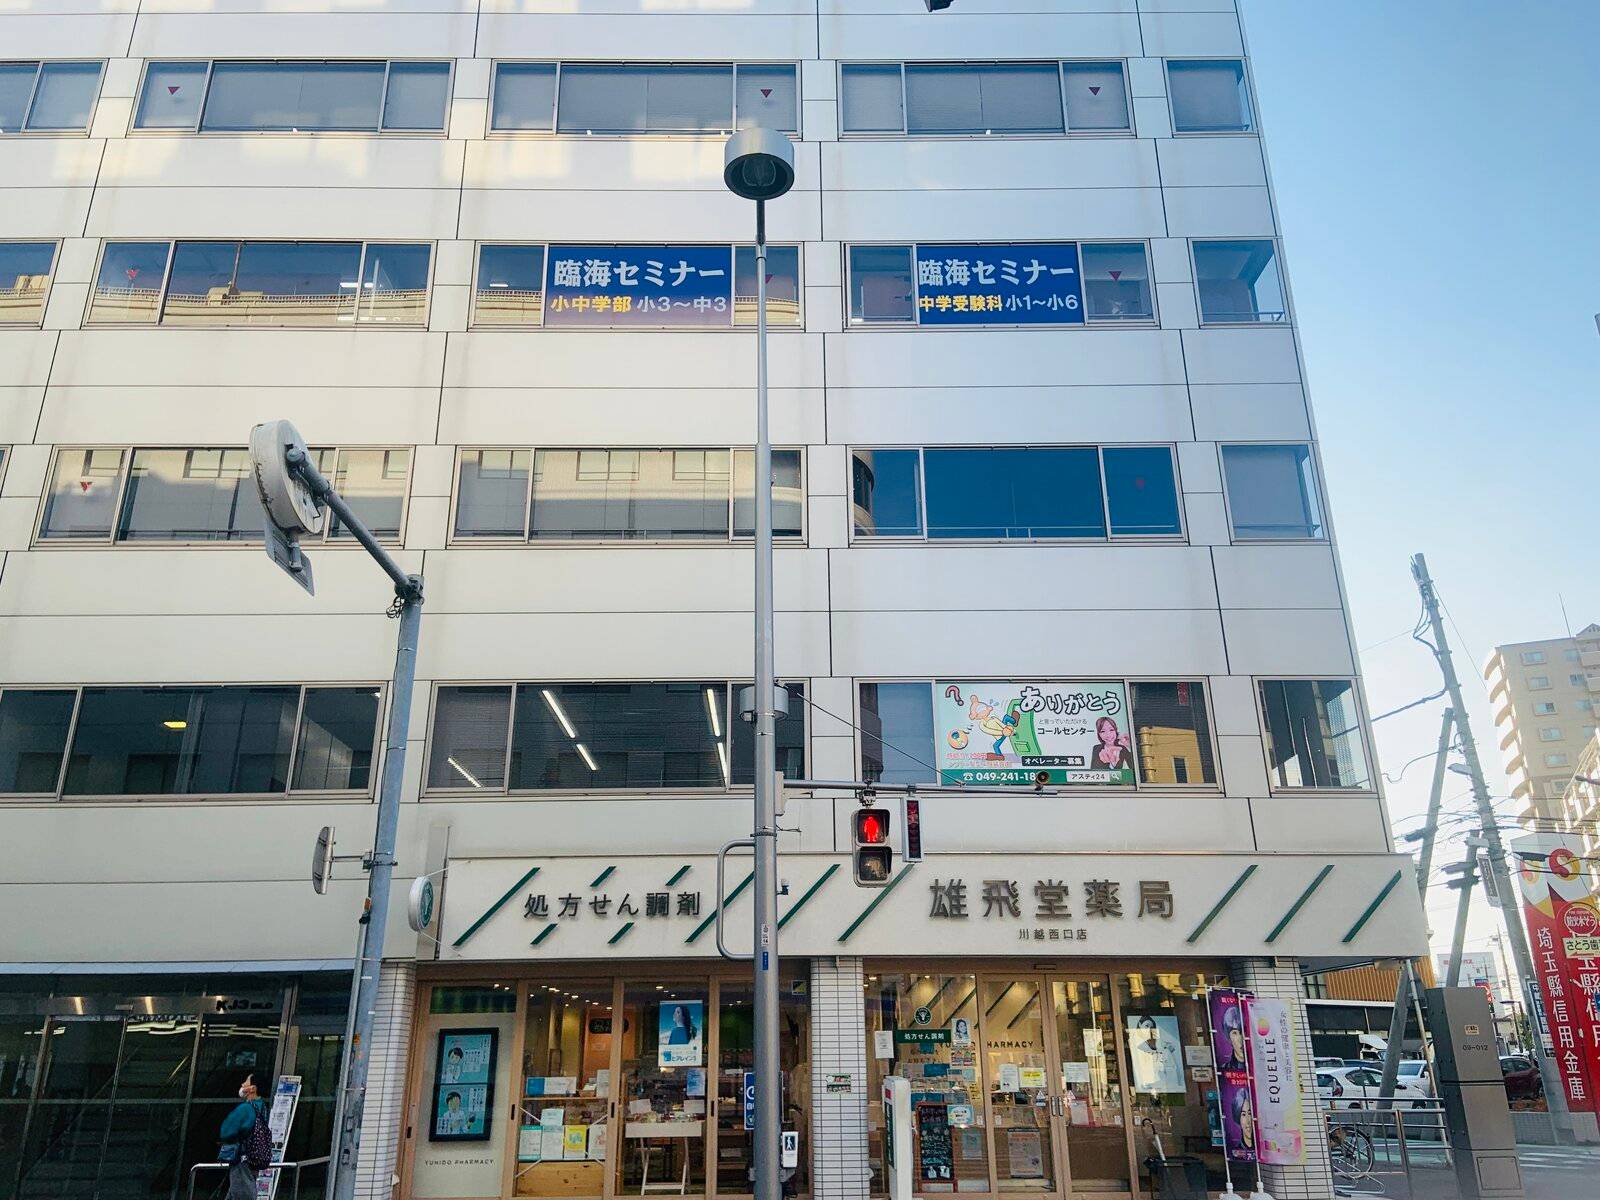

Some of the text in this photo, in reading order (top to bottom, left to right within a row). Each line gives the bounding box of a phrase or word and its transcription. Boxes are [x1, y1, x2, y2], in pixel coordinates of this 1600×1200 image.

[554, 259, 725, 287] 臨海セミナー
[918, 259, 1075, 286] 臨海セミナー
[551, 295, 632, 313] 小中学部
[919, 294, 1003, 312] 中学受験科
[1019, 686, 1121, 715] ありがとう
[1037, 727, 1095, 736] コールセンター
[976, 772, 1037, 781] 049-241-18
[523, 891, 701, 918] 処方せん調剤
[929, 879, 1174, 919] 雄飛堂薬局
[1018, 928, 1088, 940] 川越西口店
[1265, 1038, 1281, 1104] EQUELLE
